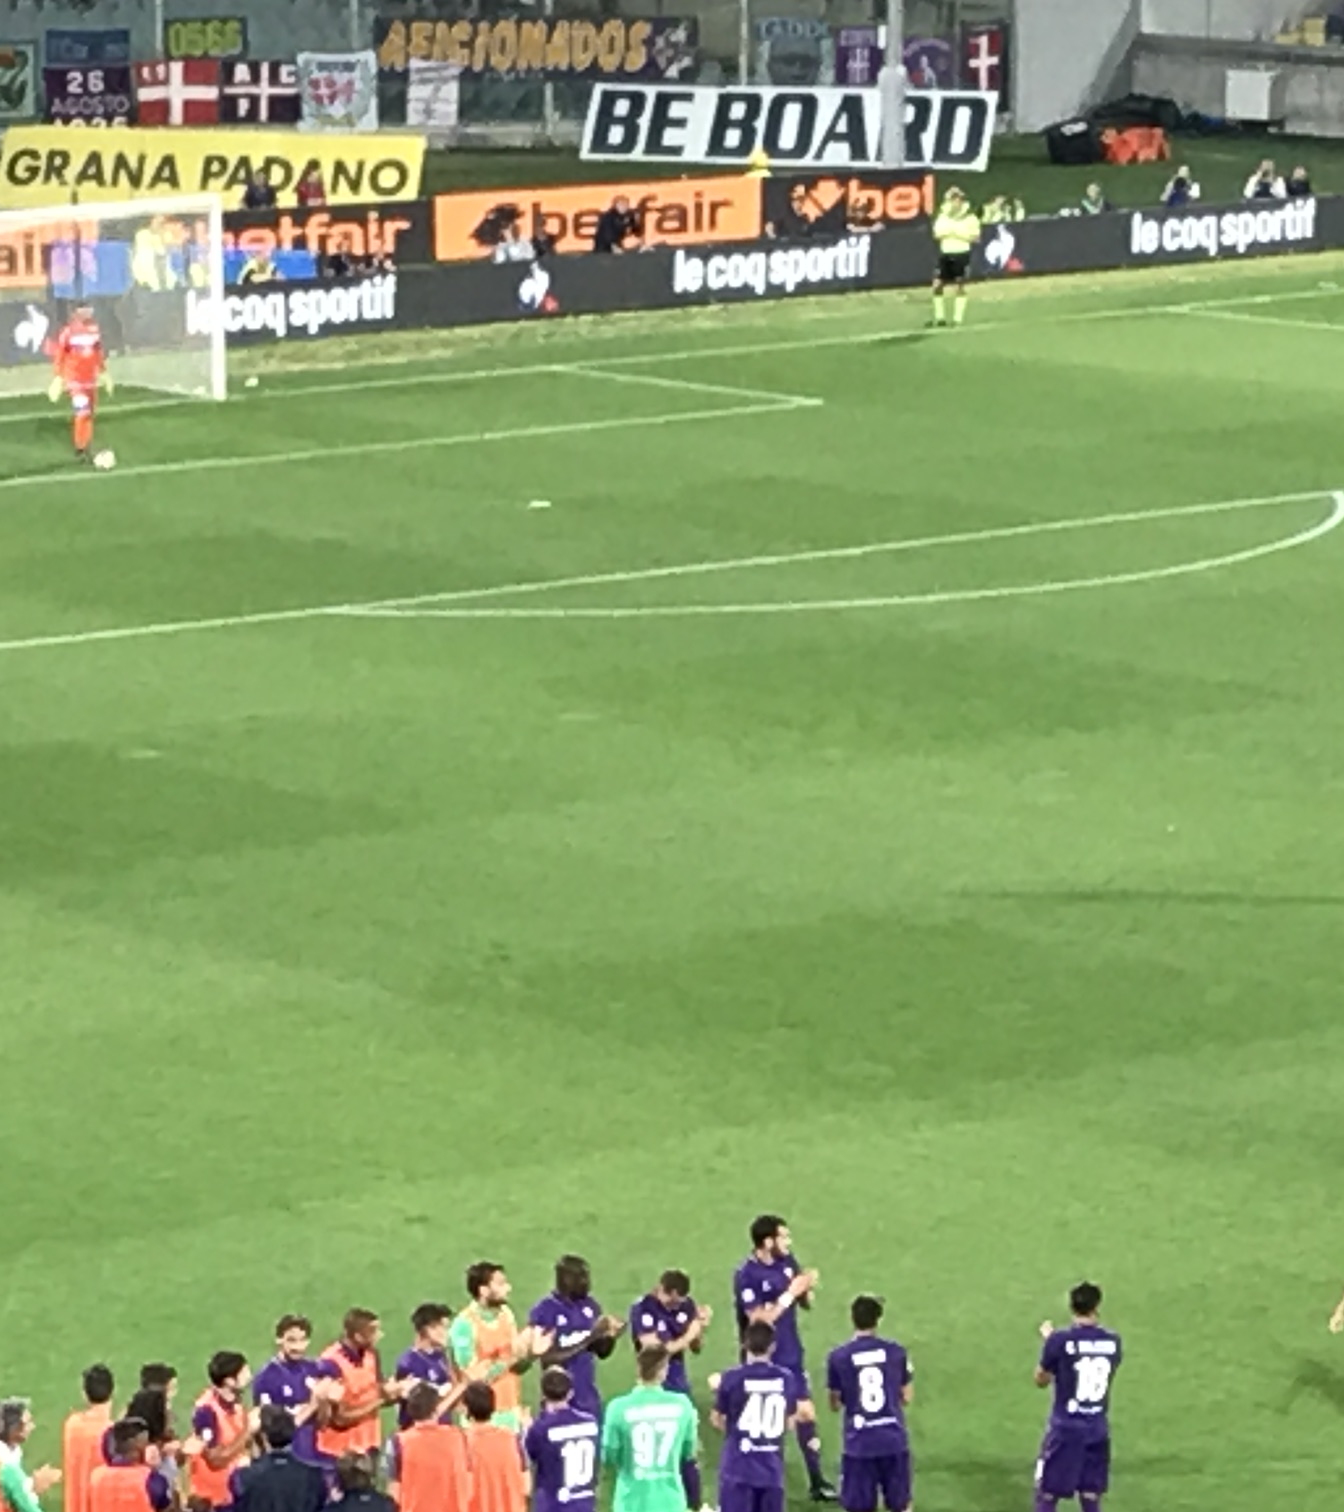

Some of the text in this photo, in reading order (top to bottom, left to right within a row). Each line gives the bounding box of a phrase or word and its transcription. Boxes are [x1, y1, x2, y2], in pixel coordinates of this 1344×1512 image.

[66, 69, 105, 94] 26
[588, 90, 694, 156] BE
[5, 147, 409, 197] GRANA PADANO
[1131, 199, 1316, 257] le coq sportif
[674, 235, 870, 294] le coq sportif
[224, 289, 286, 338] coq
[288, 273, 397, 336] sportif
[858, 1366, 886, 1414] 8
[737, 1392, 787, 1440] 40
[560, 1438, 596, 1488] 10
[631, 1421, 678, 1468] 97
